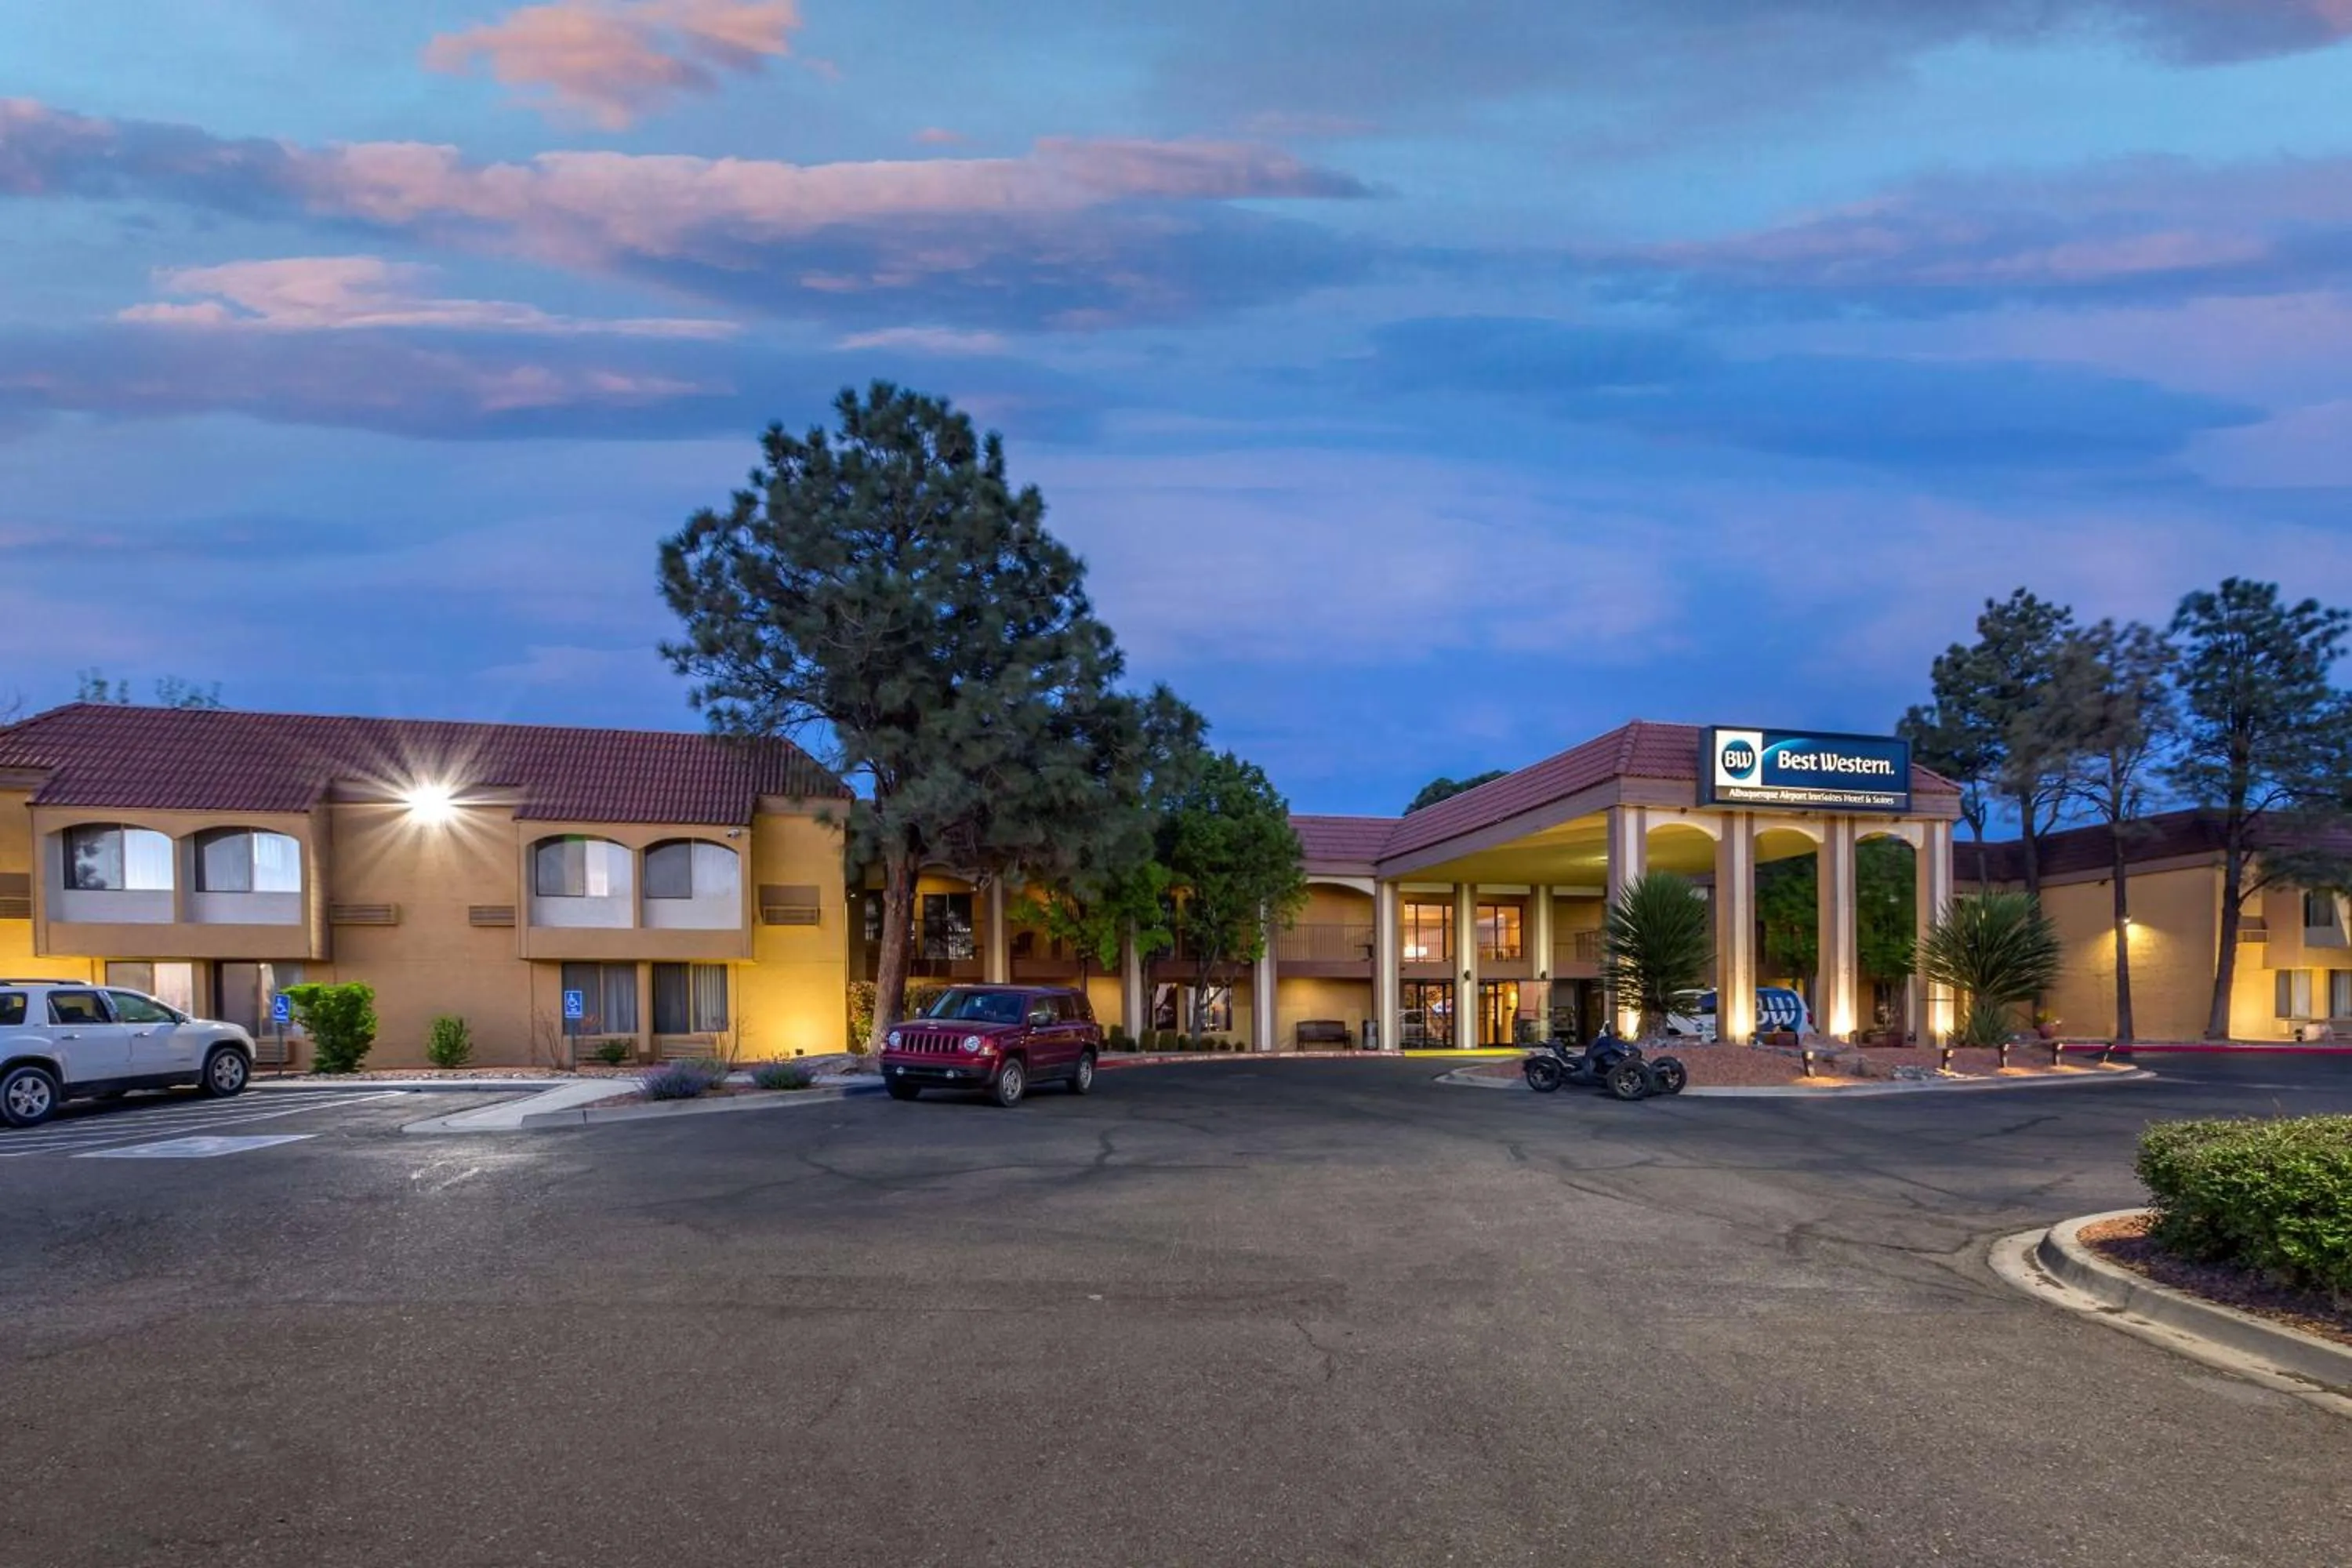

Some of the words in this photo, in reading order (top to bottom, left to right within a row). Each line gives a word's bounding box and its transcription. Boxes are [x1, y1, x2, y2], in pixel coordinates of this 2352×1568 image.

[1726, 750, 1753, 768] BW
[1778, 750, 1817, 769] Best
[1780, 789, 1807, 802] Airport
[1843, 793, 1864, 803] Hotel
[1865, 795, 1871, 804] &
